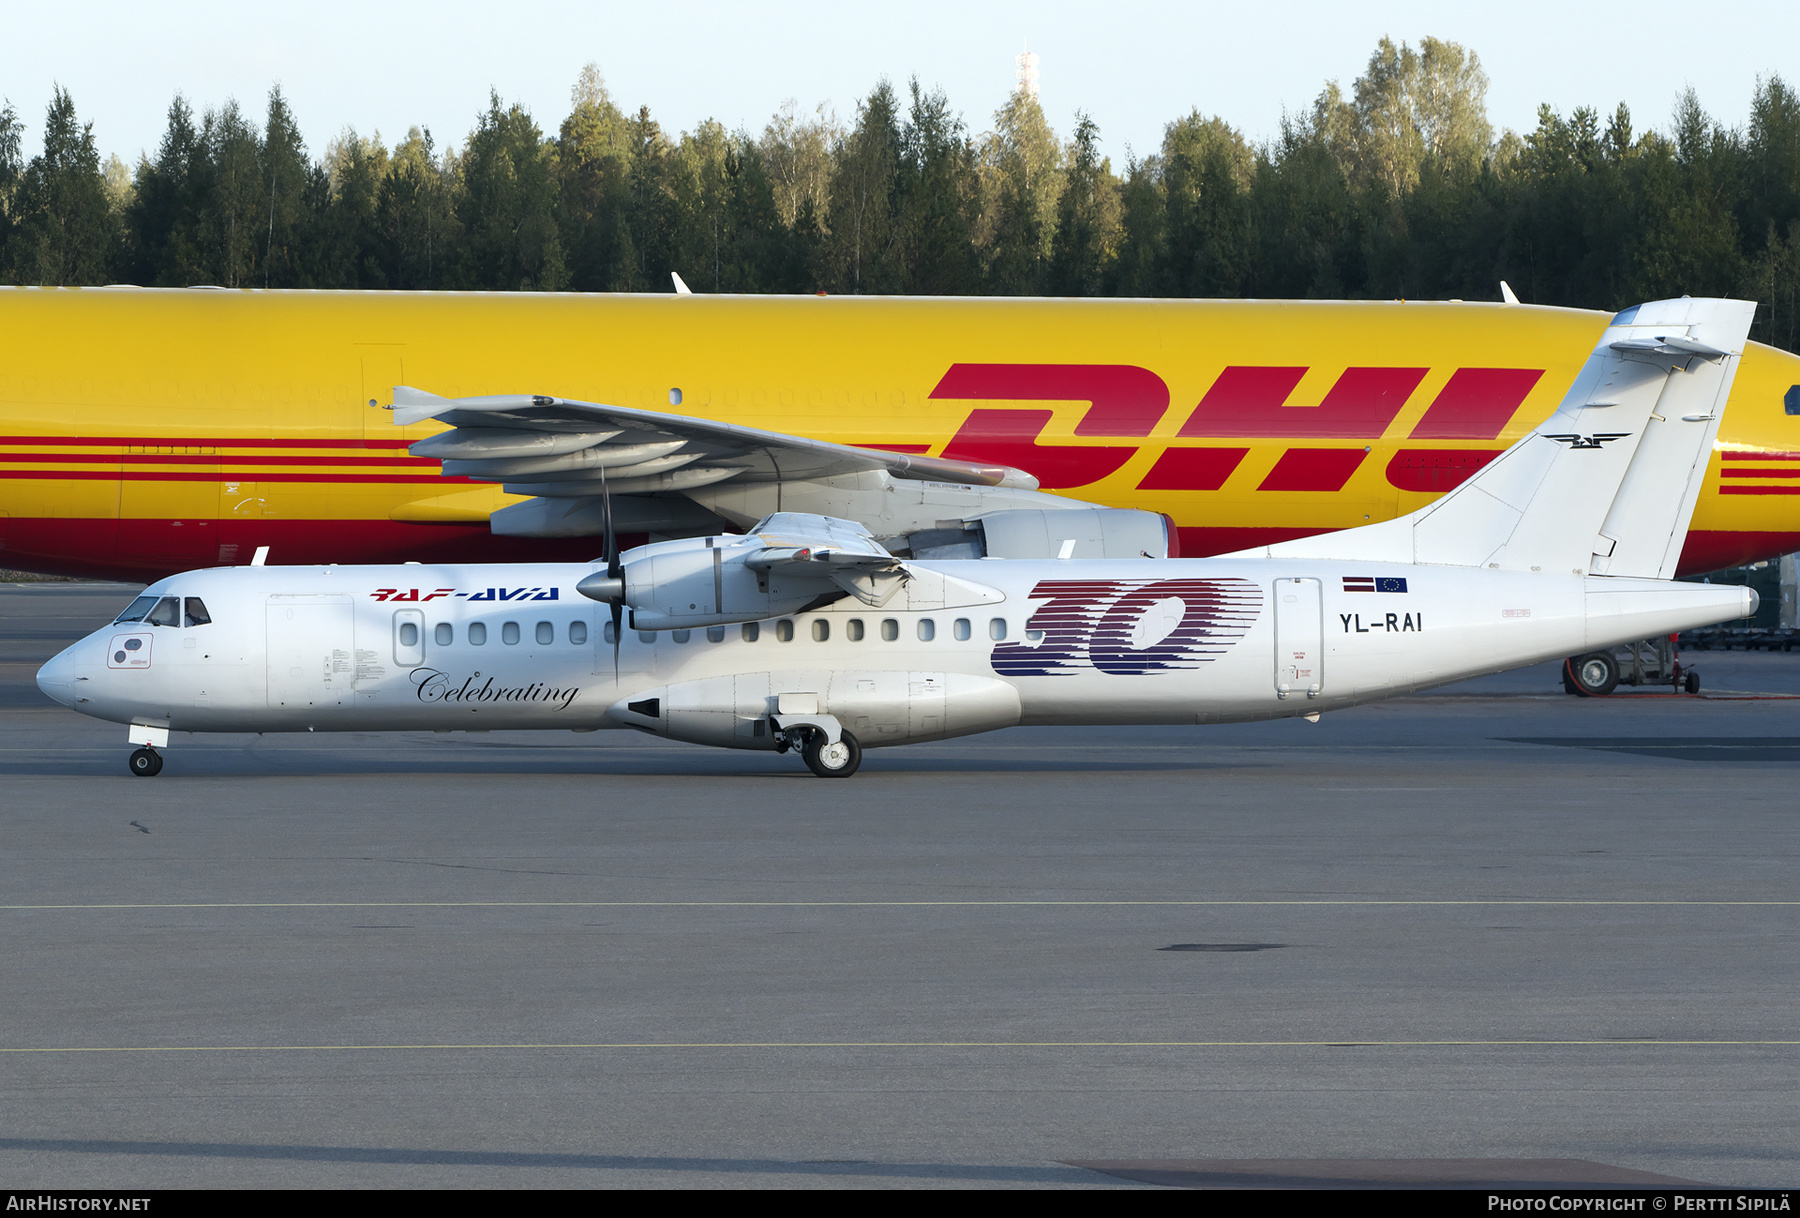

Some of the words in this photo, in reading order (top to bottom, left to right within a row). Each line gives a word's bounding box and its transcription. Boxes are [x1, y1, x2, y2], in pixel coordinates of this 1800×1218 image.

[928, 363, 1546, 492] DHL
[990, 578, 1264, 676] 30
[1339, 612, 1422, 633] YL-RAI
[409, 667, 581, 712] Celebrating
